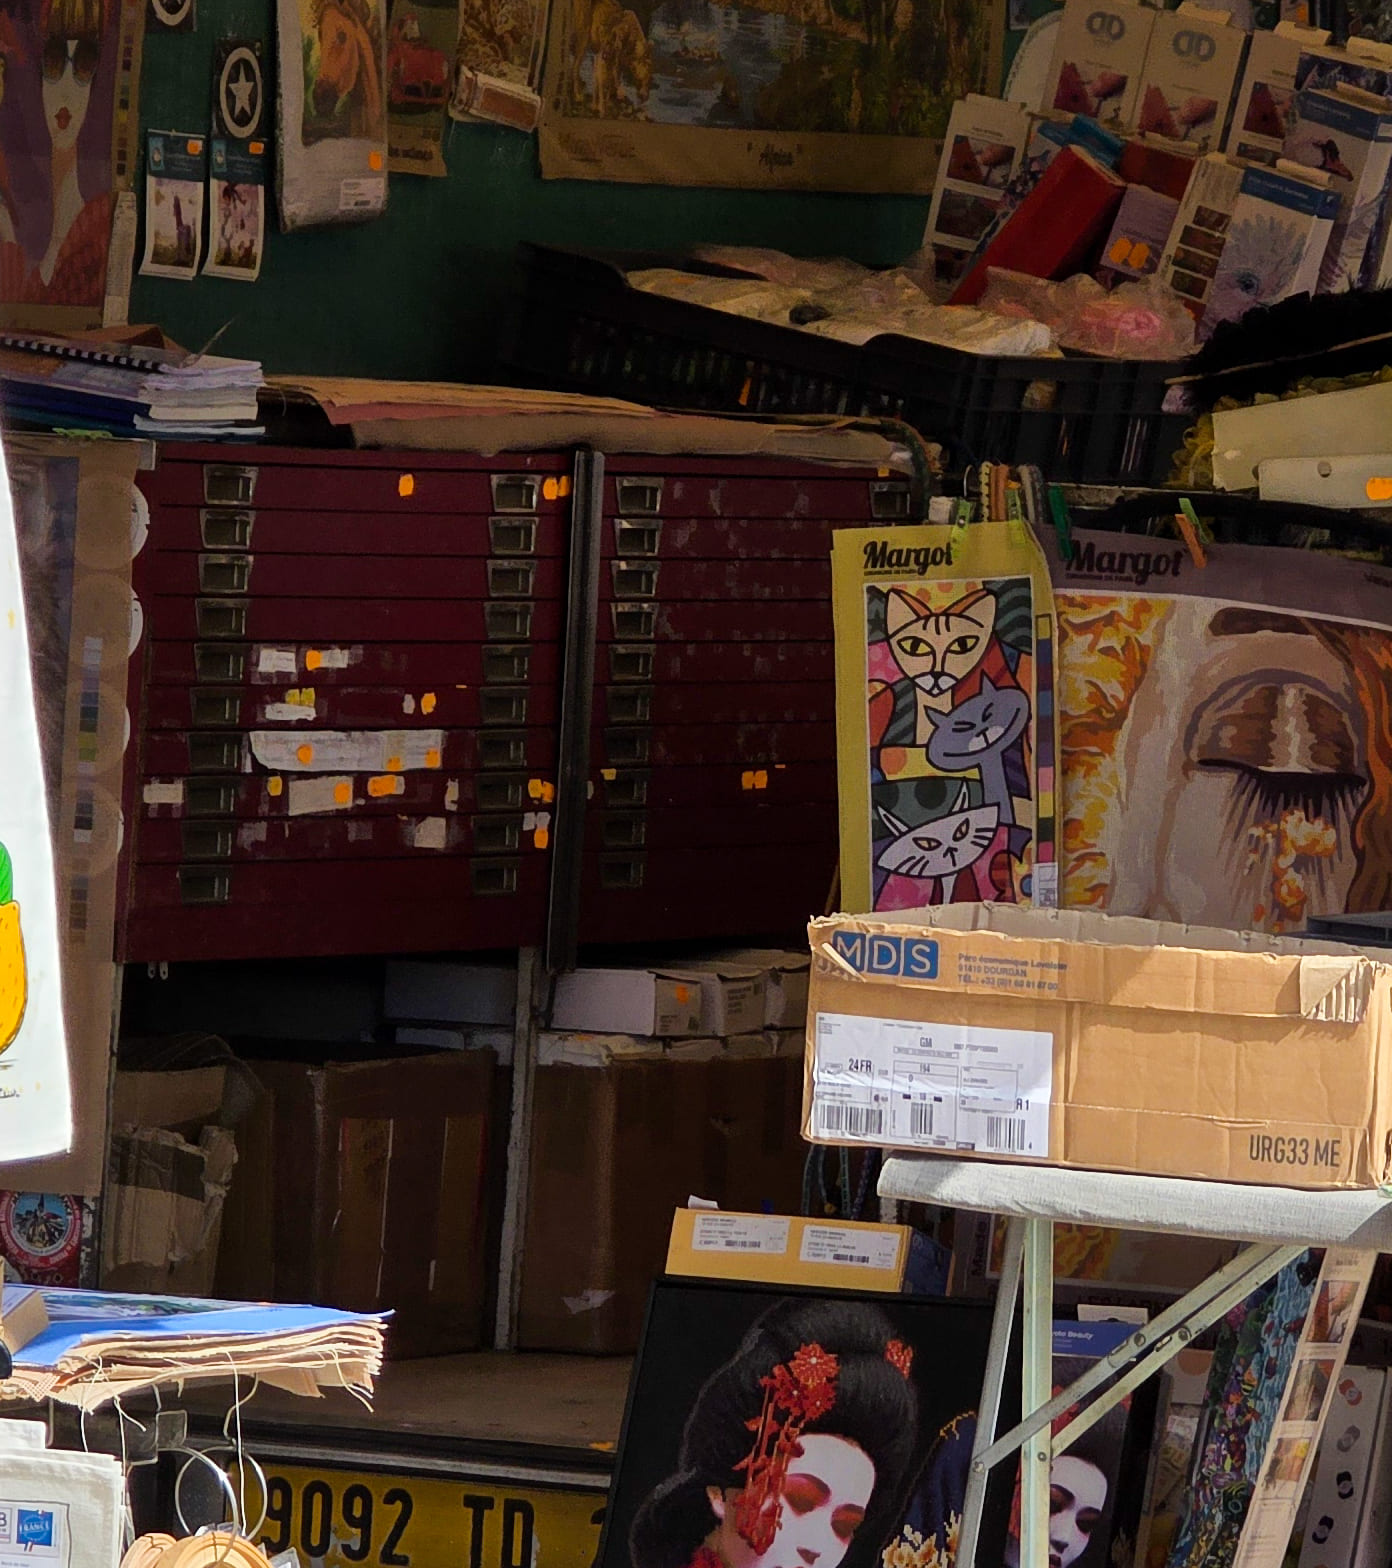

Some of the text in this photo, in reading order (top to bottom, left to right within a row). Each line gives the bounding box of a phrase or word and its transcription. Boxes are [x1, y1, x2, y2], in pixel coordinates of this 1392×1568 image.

[864, 540, 953, 576] Margot
[1066, 539, 1184, 586] Margot
[836, 935, 932, 974] MDS
[1249, 1134, 1341, 1168] URG33 ME
[260, 1475, 413, 1567] 9092
[463, 1492, 535, 1568] TD
